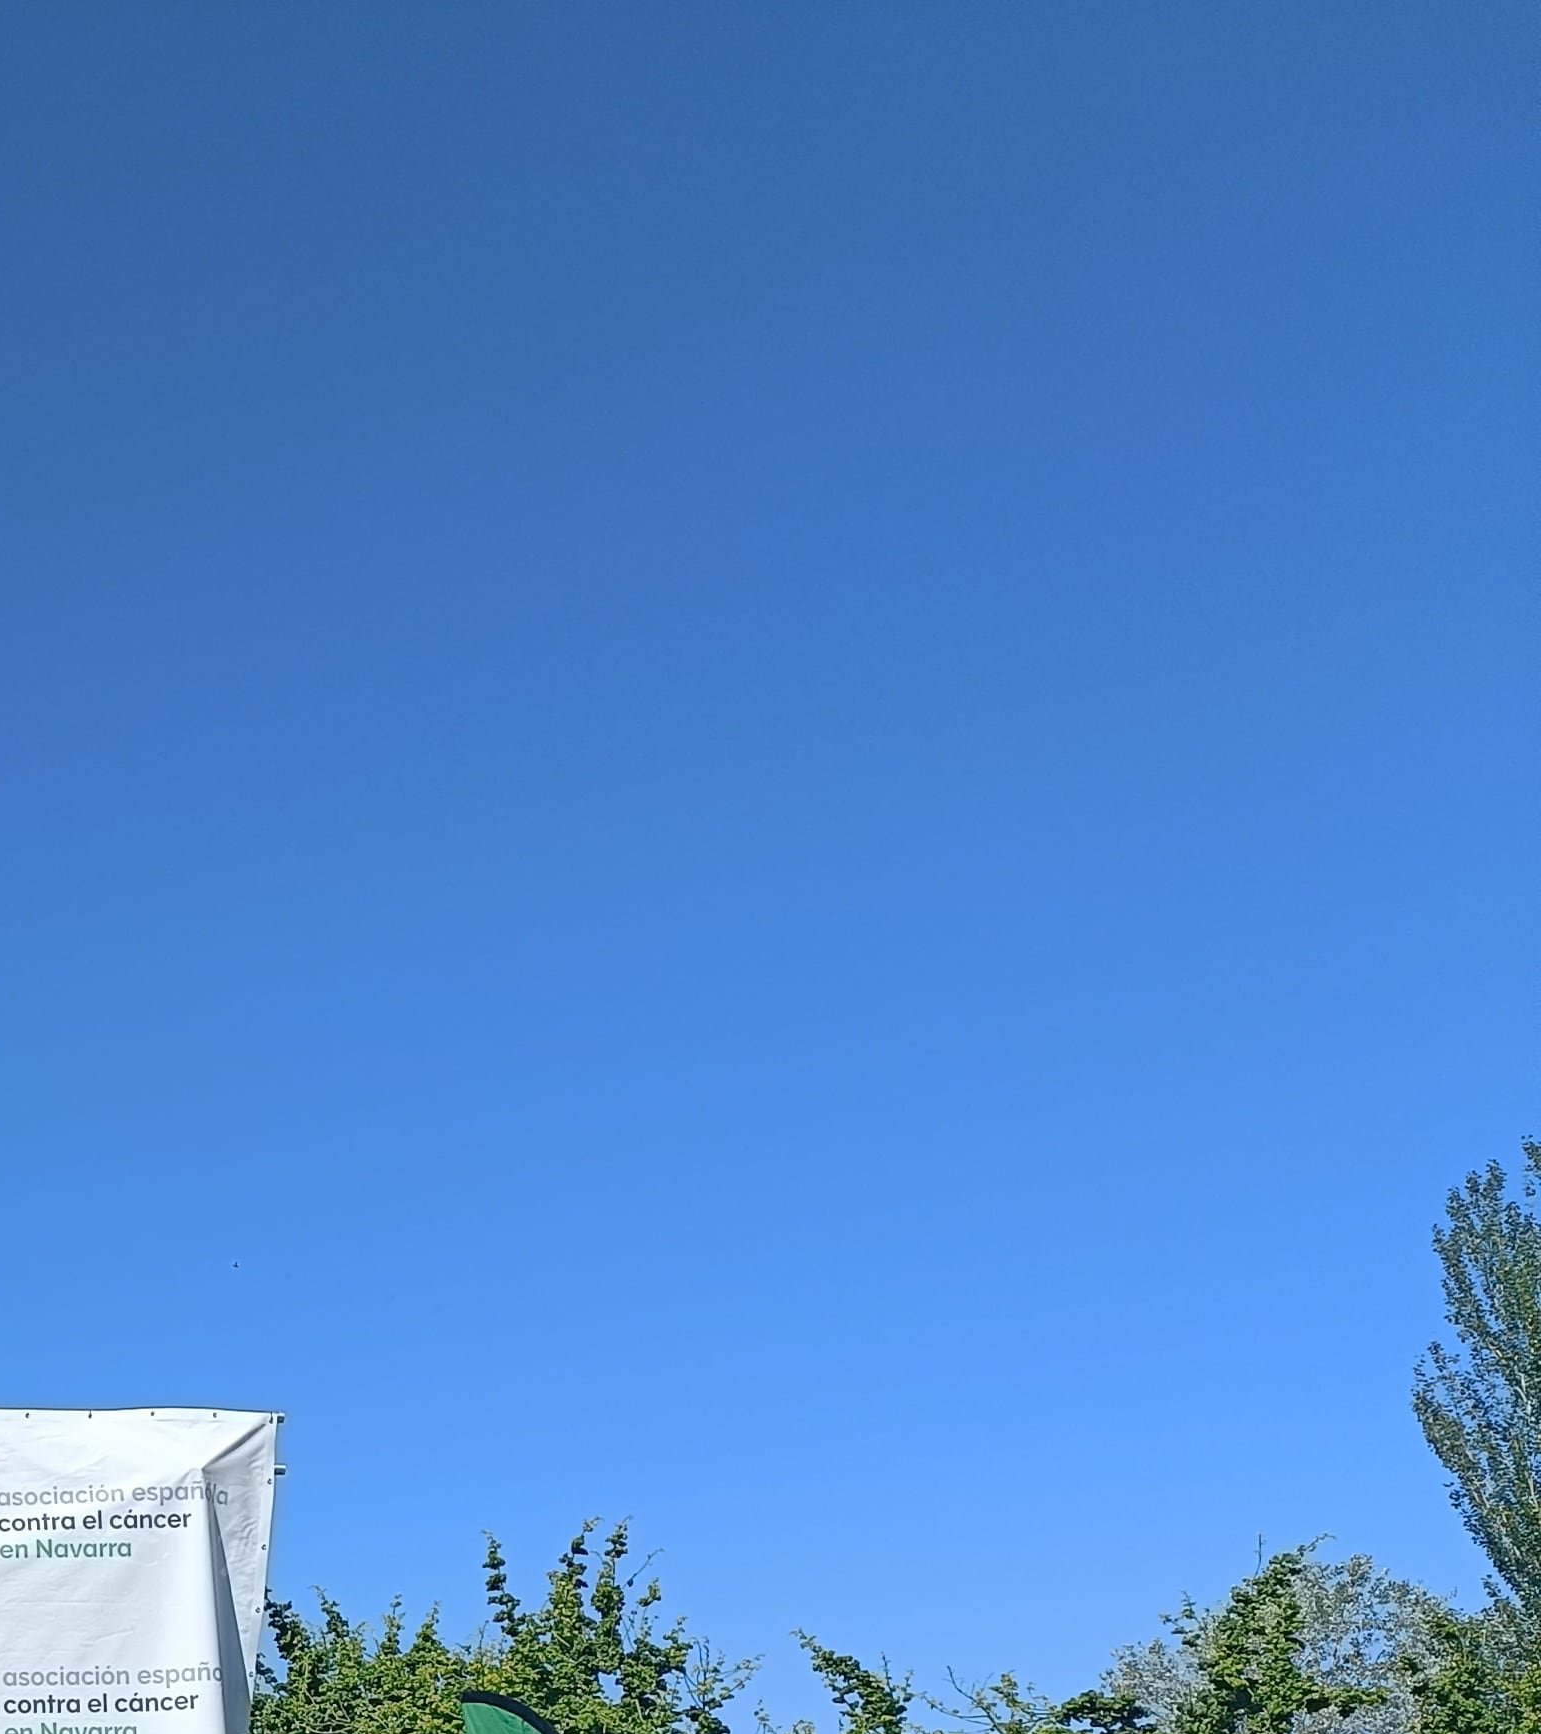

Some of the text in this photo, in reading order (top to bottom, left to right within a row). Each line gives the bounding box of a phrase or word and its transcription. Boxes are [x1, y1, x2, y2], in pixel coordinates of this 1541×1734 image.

[82, 1508, 103, 1530] el
[109, 1506, 192, 1530] cáncer
[0, 1536, 132, 1559] en Navarra
[2, 1660, 223, 1688] asociación españo
[3, 1690, 199, 1716] contra el cáncer
